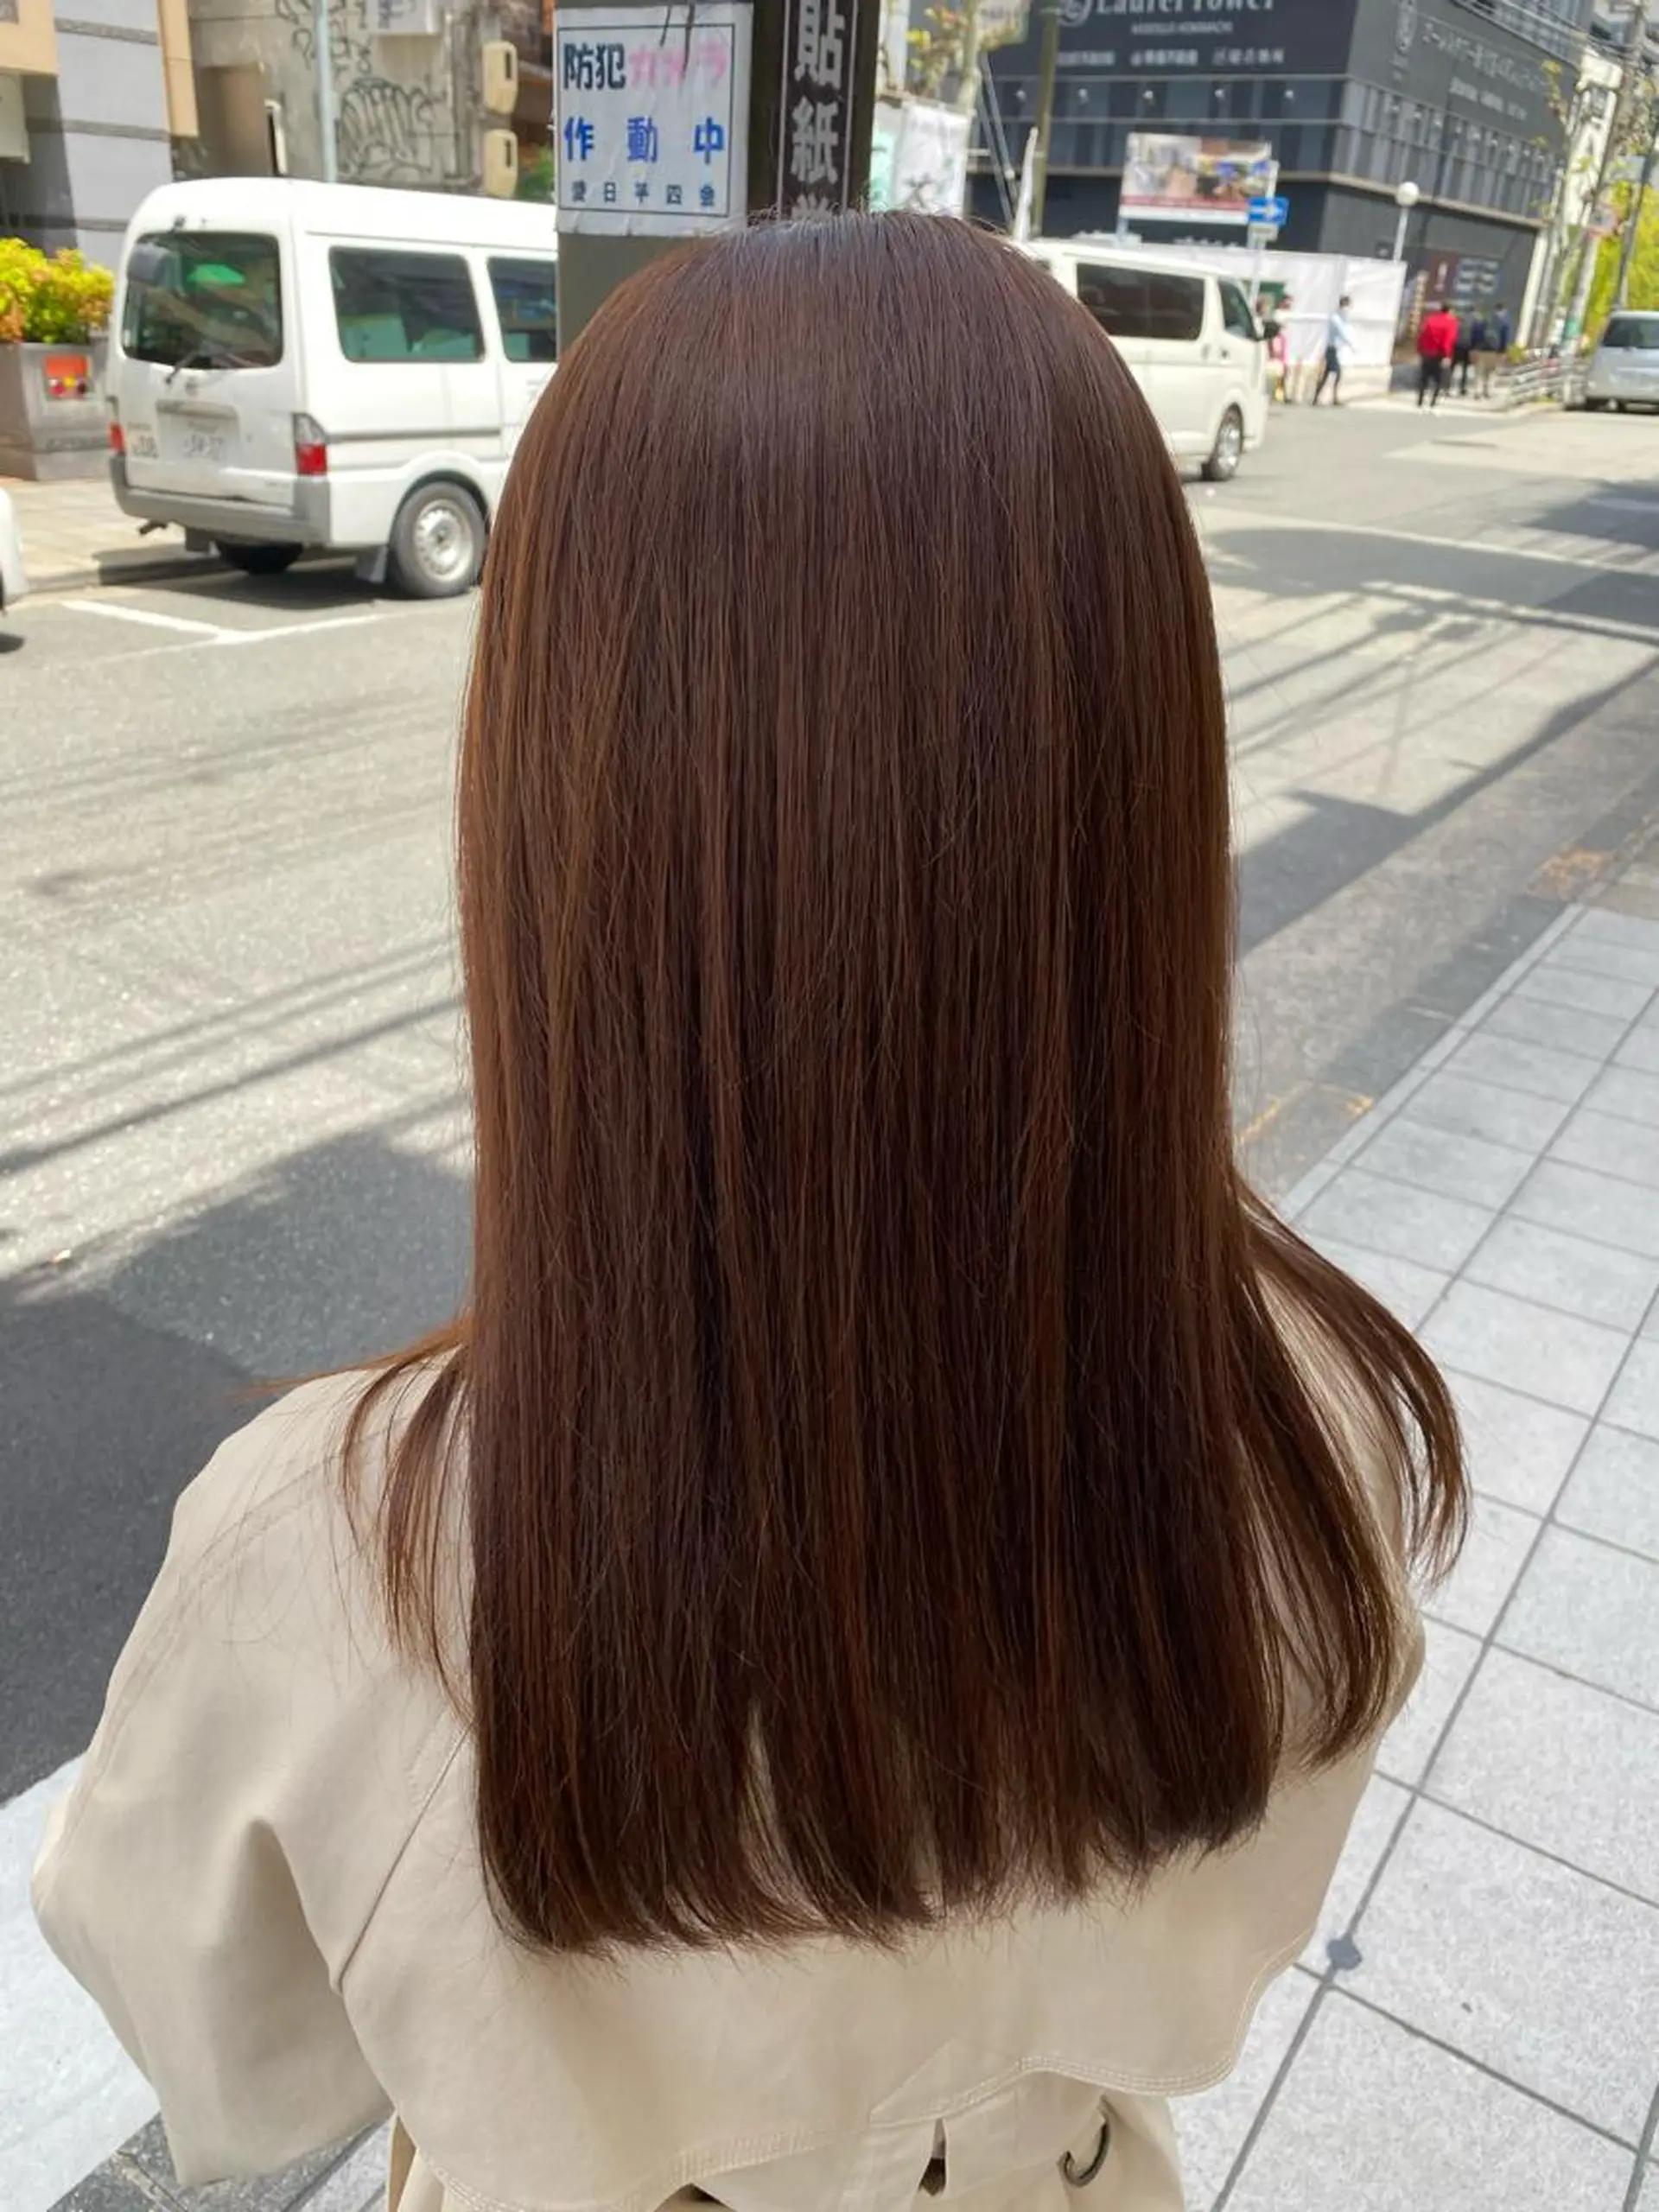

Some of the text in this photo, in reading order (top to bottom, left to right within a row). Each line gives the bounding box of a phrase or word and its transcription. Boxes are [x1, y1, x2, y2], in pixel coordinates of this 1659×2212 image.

[564, 116, 724, 164] 作動中
[790, 0, 846, 217] 貼紙
